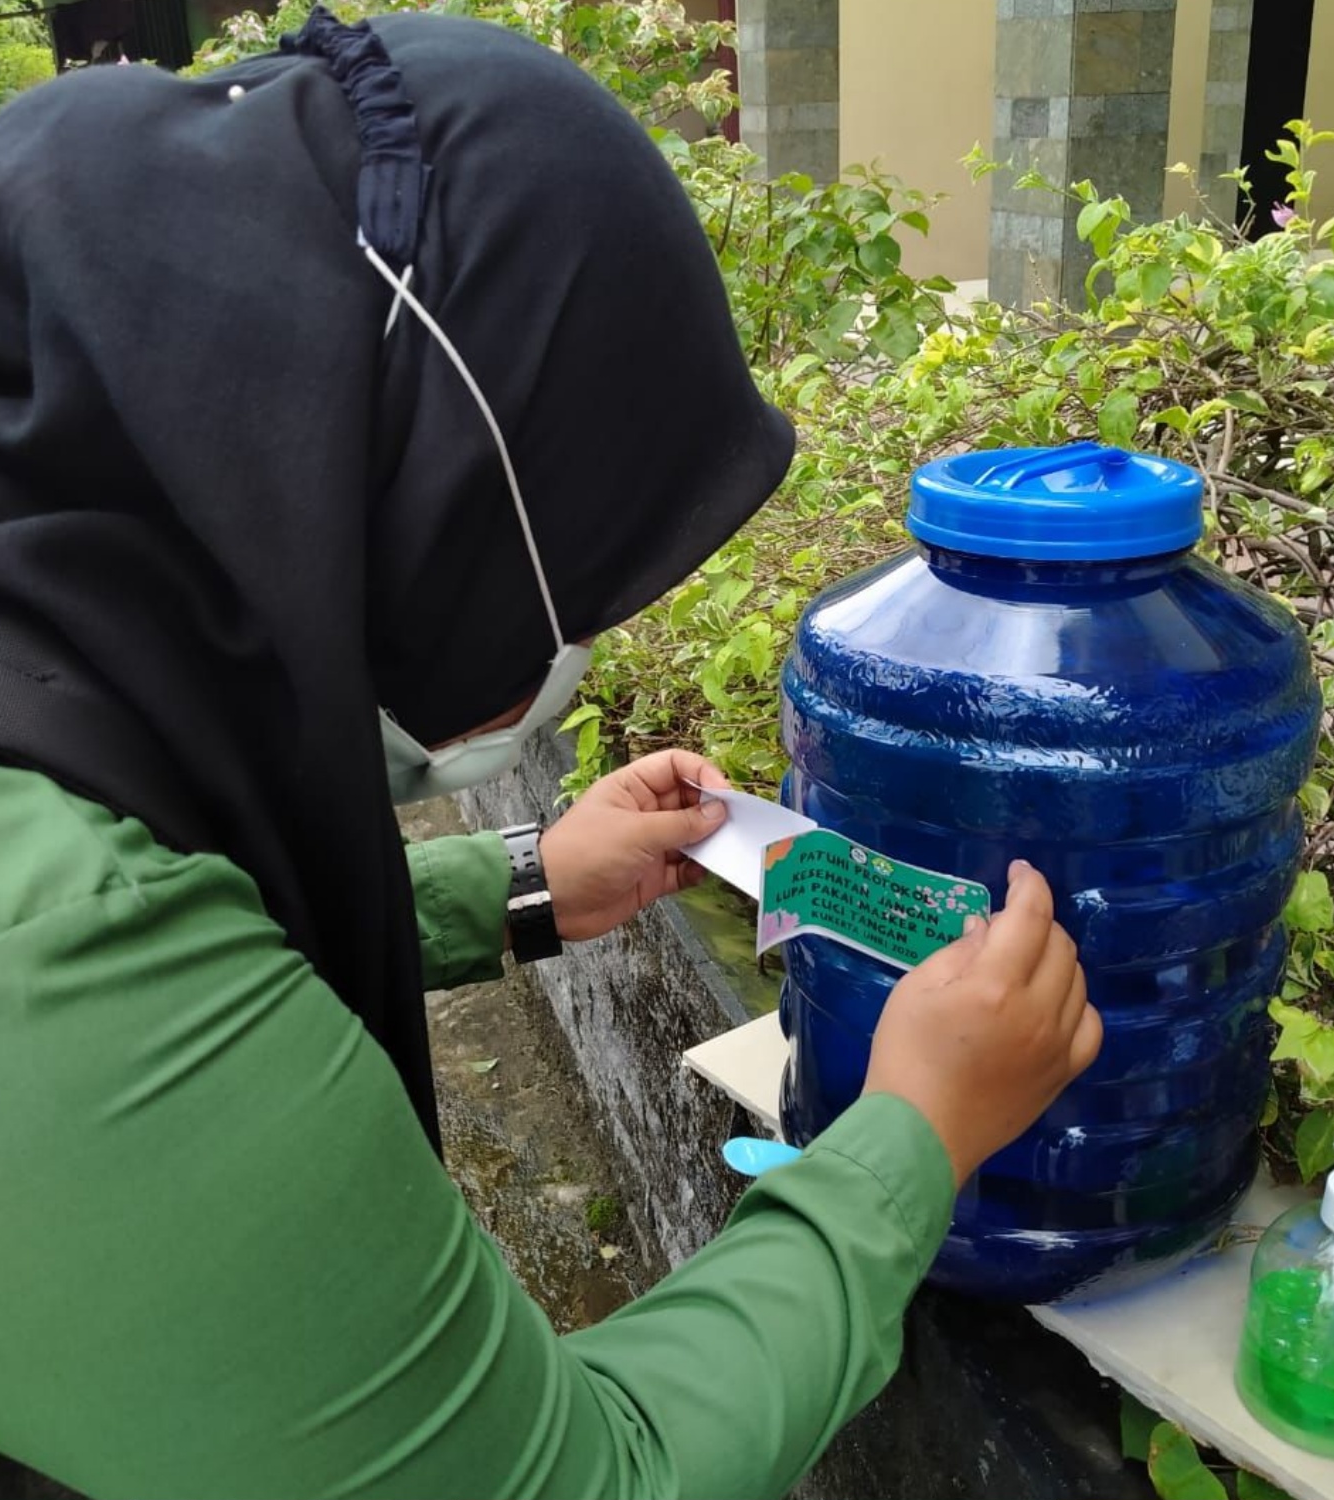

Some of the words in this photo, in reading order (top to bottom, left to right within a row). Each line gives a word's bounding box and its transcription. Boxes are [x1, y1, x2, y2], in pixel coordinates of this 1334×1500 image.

[793, 868, 870, 896] KESEHATAN
[878, 896, 939, 926] JANGAN
[799, 850, 849, 871] PATUHI
[854, 865, 936, 906] PROTOKOL
[776, 886, 805, 903] LUPA
[811, 883, 853, 905] PAKAI
[858, 900, 917, 932] MASKER
[811, 897, 845, 915] CUCI
[850, 910, 908, 943] TANGAN
[892, 945, 917, 959] 2020
